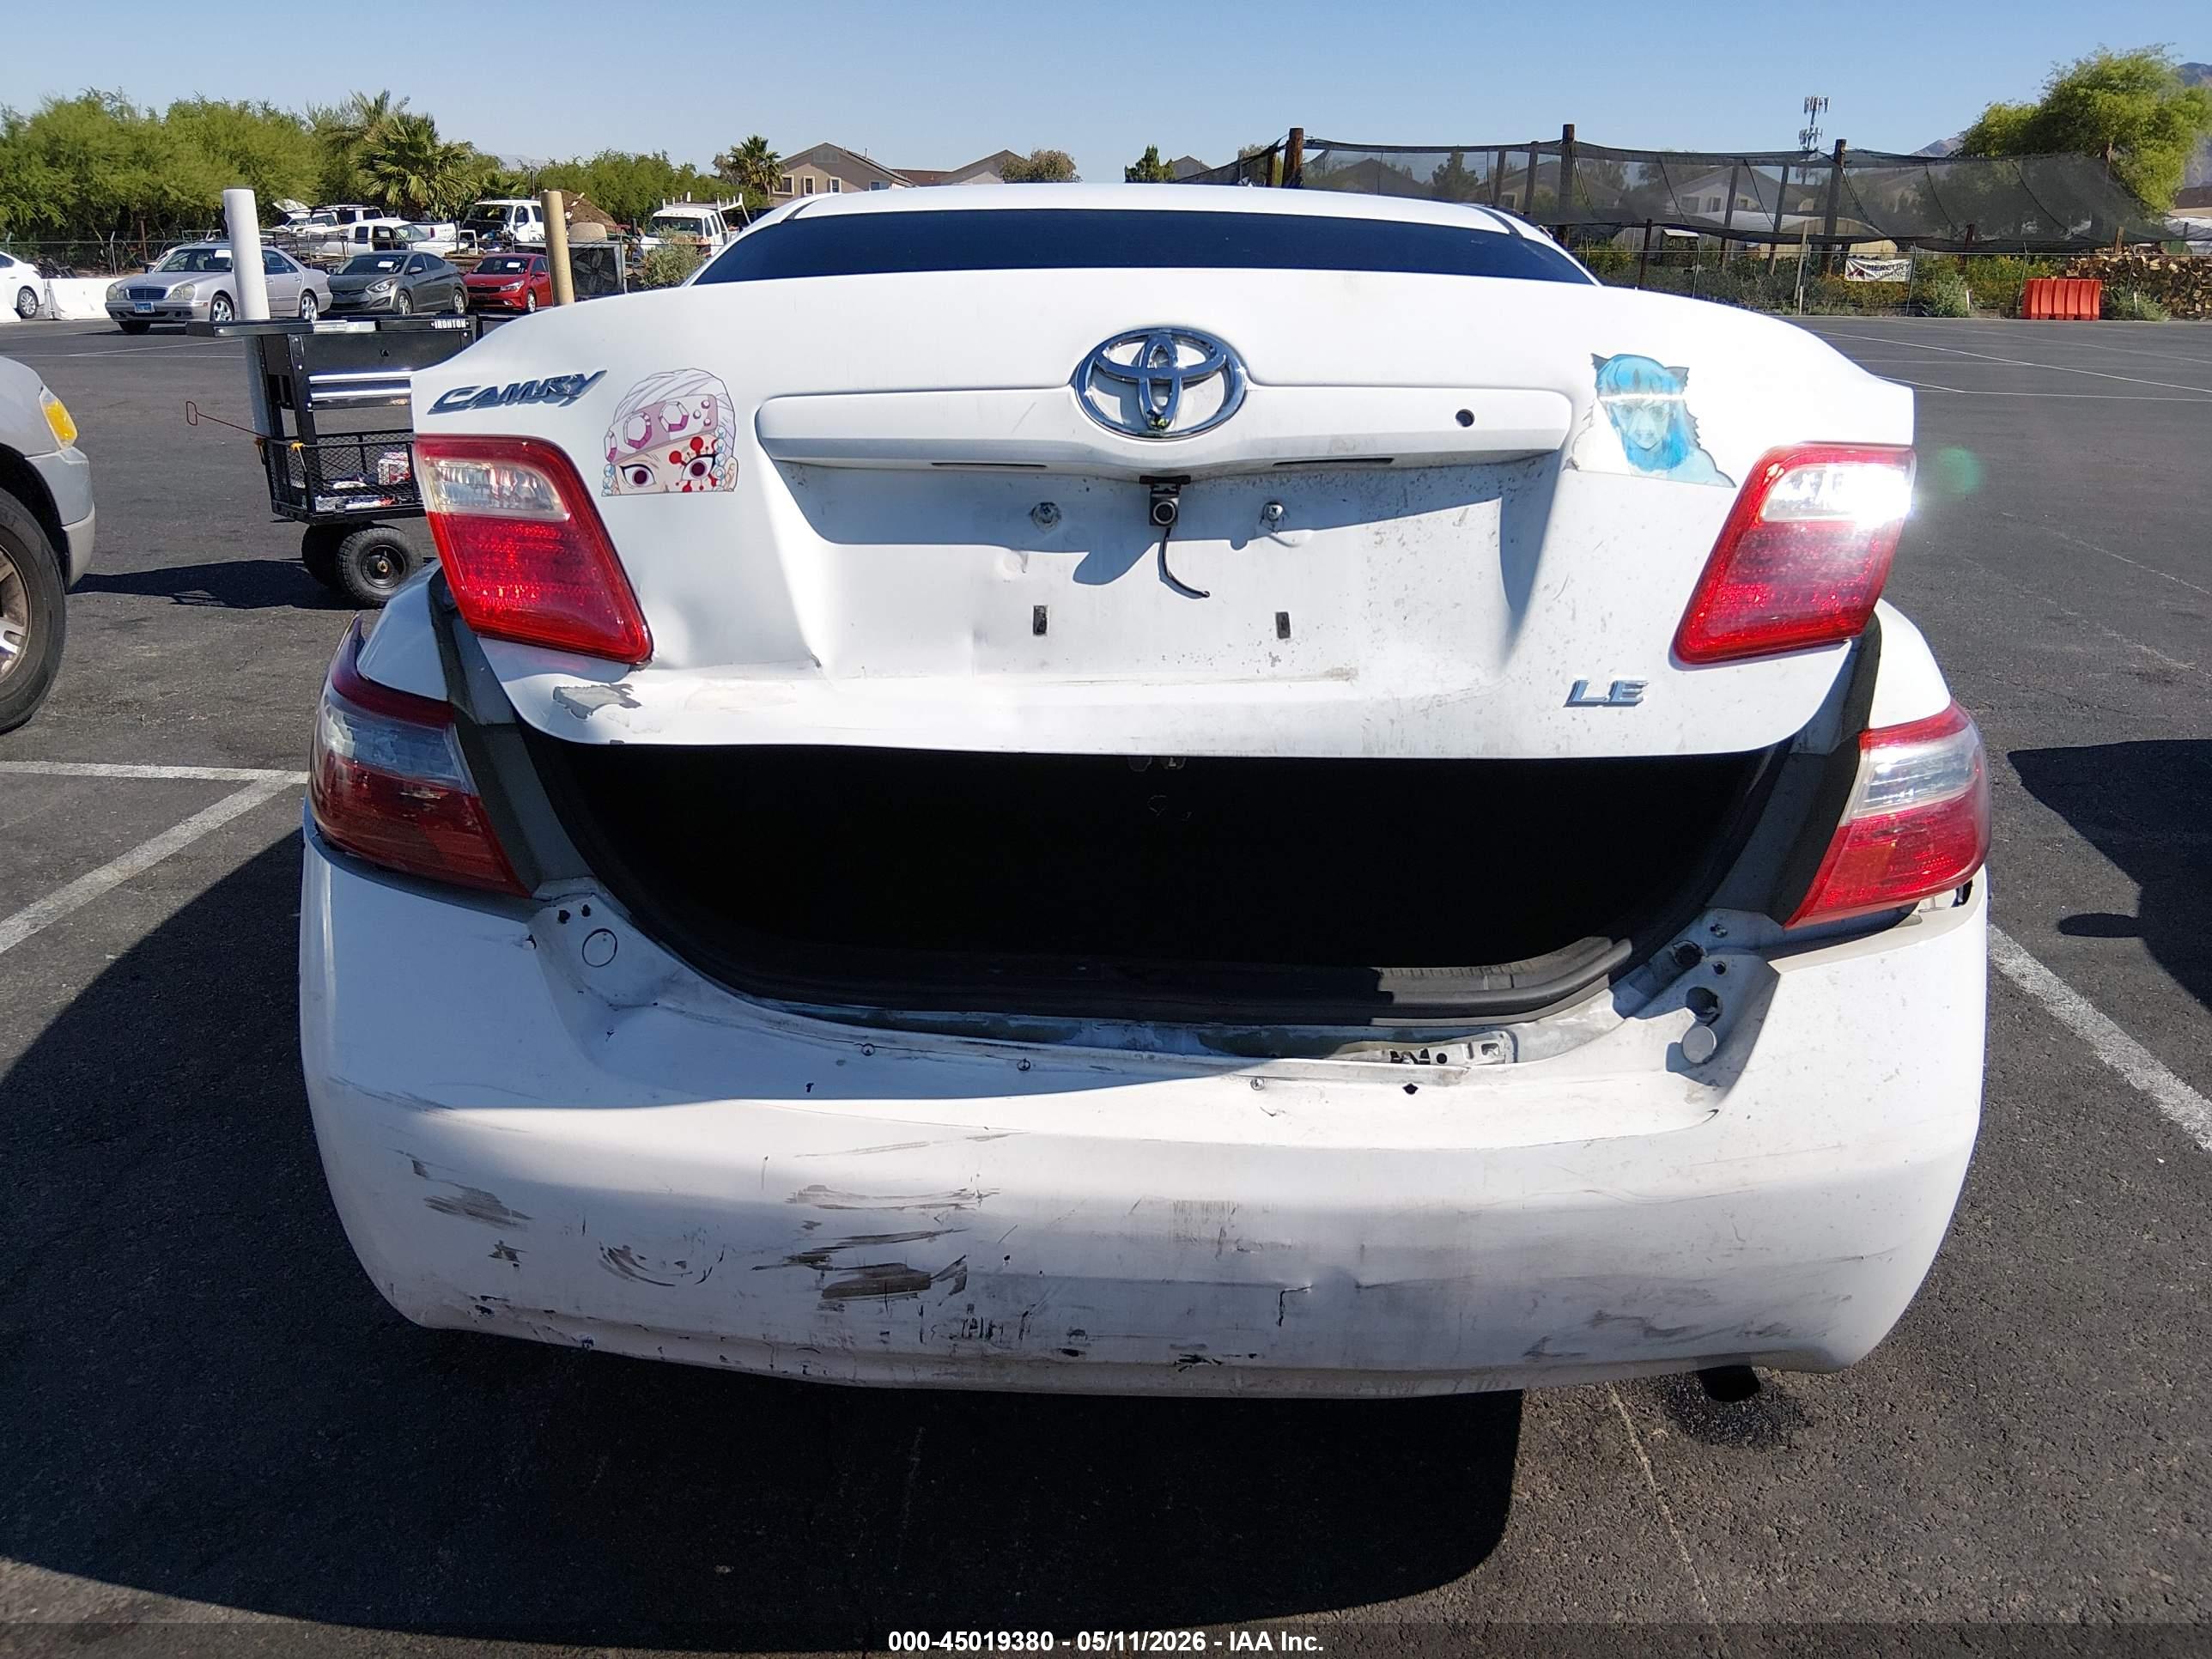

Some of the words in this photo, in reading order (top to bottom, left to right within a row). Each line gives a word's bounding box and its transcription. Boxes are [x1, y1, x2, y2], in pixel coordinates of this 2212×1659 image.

[1867, 261, 1911, 271] MERCURY
[434, 319, 466, 329] IRONTON
[427, 370, 608, 415] CAMRY
[1563, 679, 1649, 708] LE
